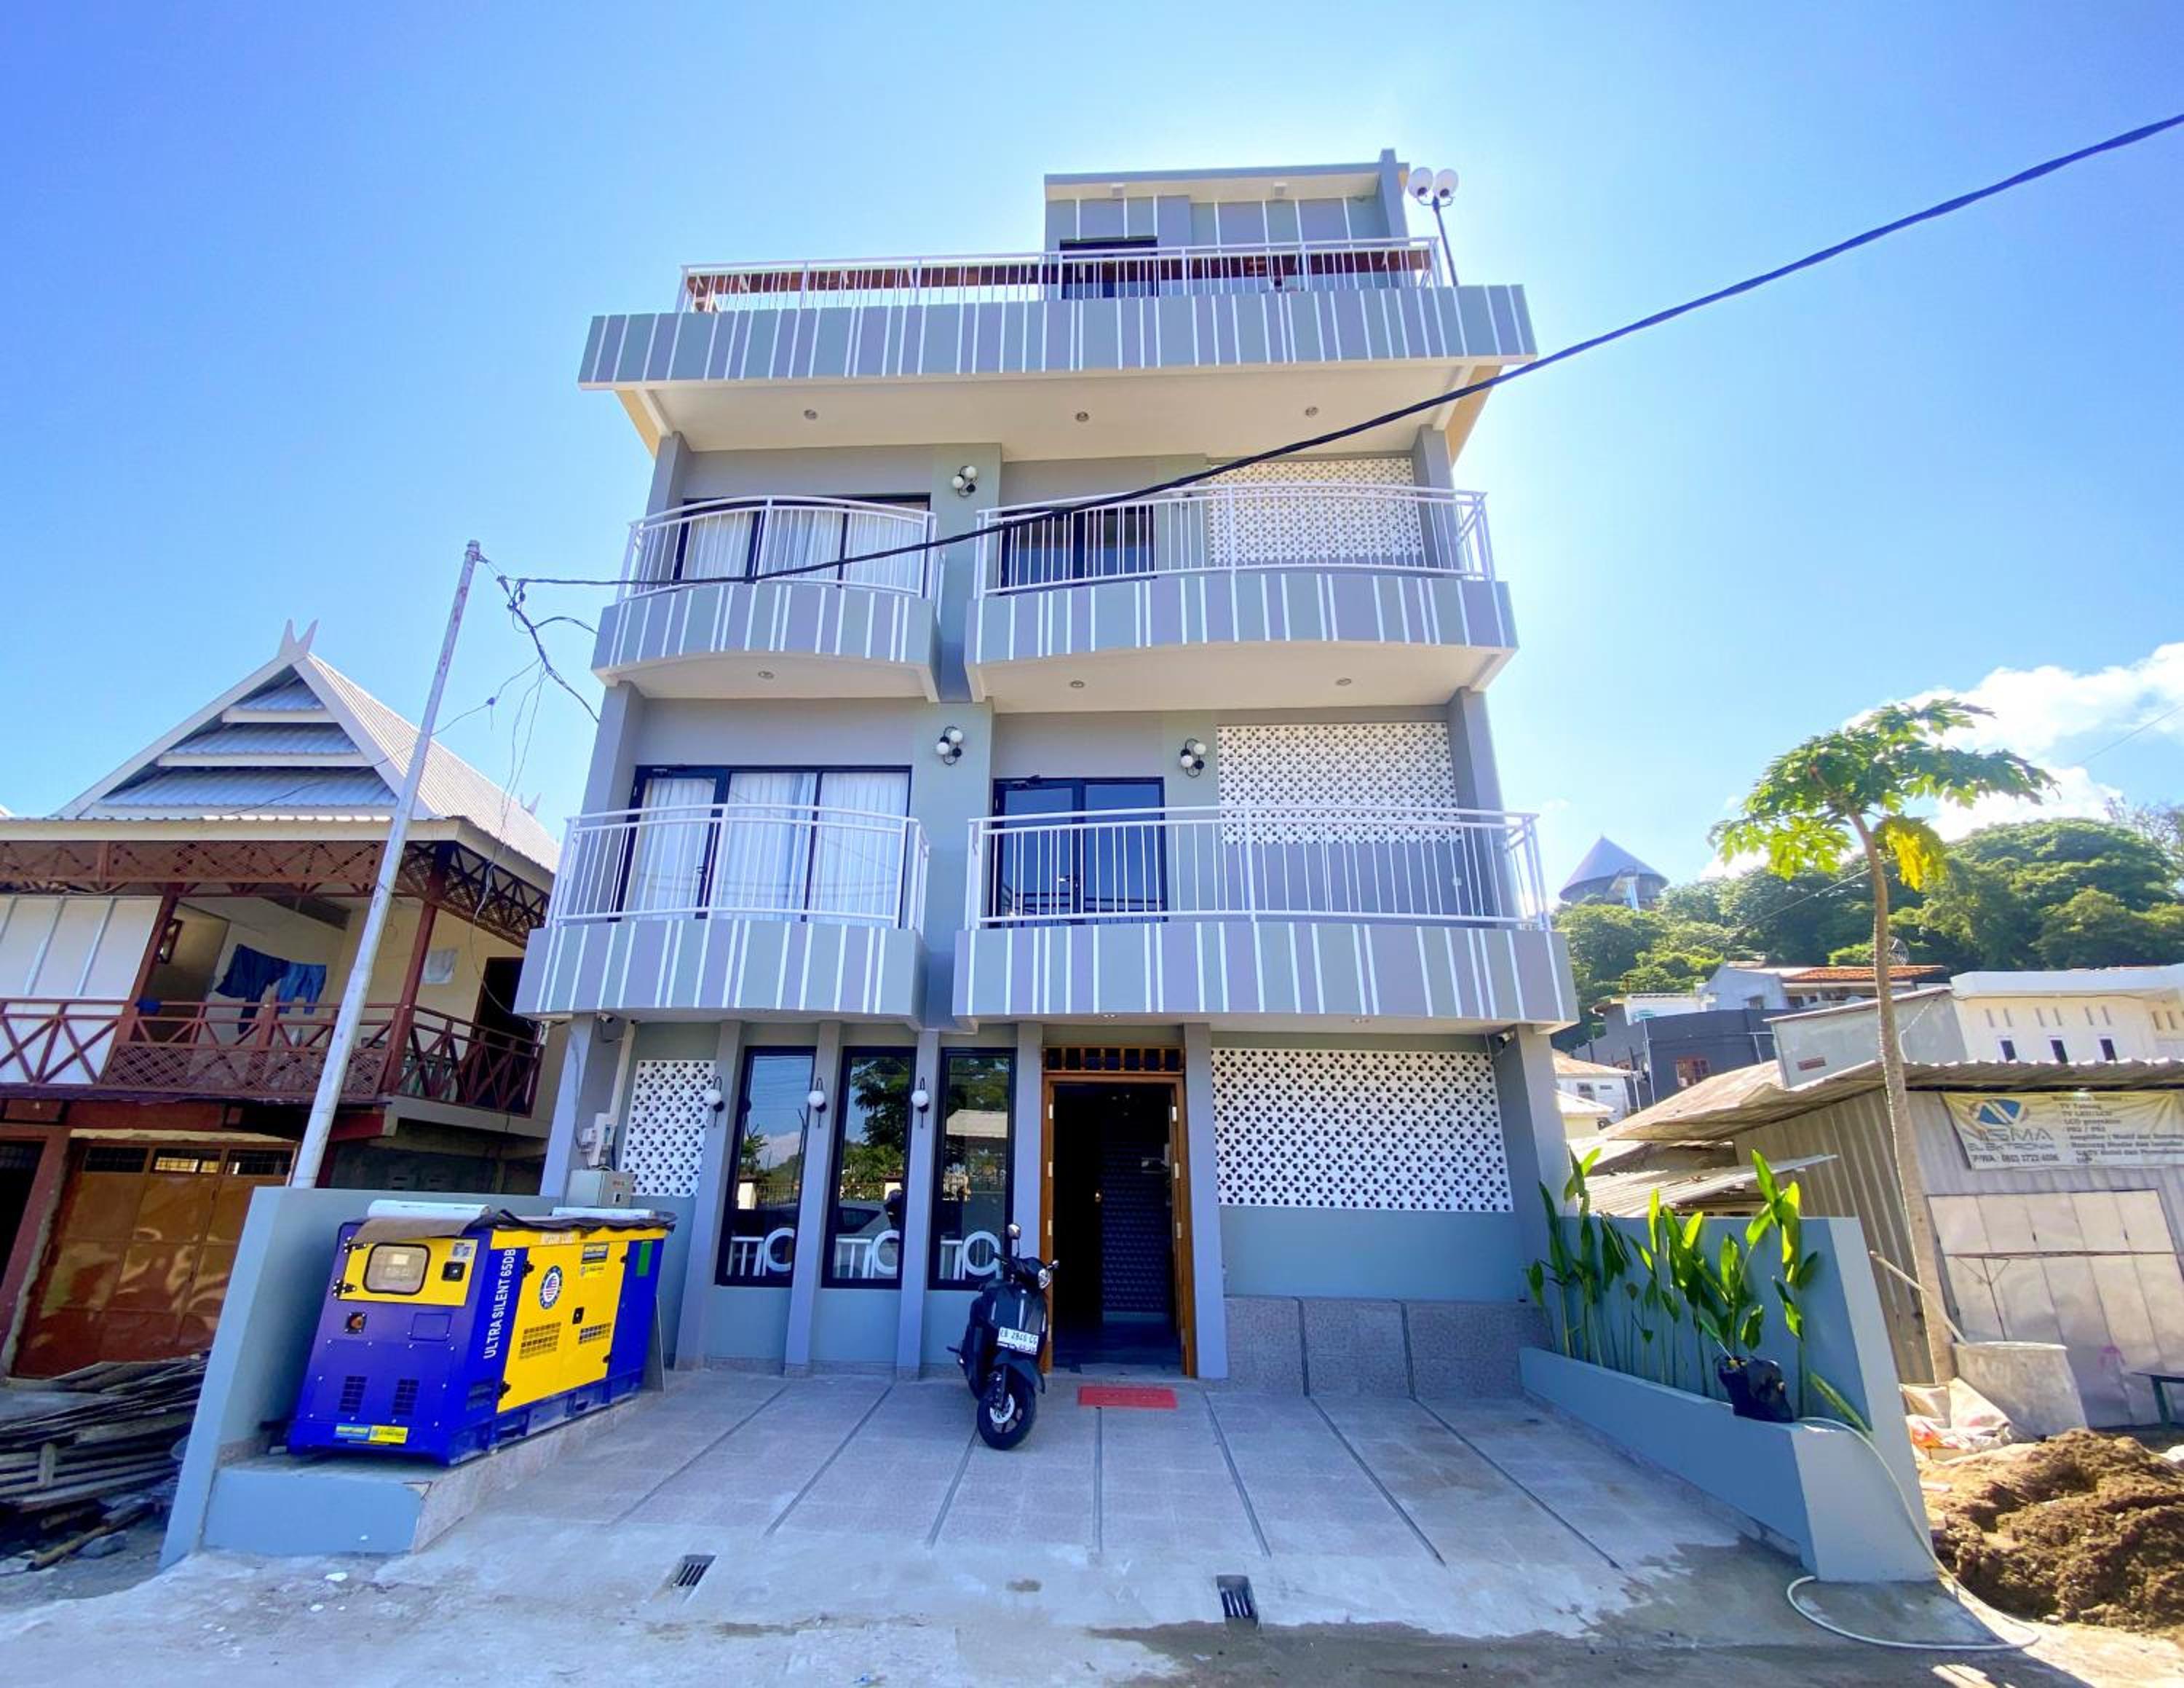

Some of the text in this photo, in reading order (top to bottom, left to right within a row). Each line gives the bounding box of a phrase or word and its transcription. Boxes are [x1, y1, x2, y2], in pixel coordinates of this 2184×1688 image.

[483, 1248, 516, 1360] ULTRA SILENT 65DB
